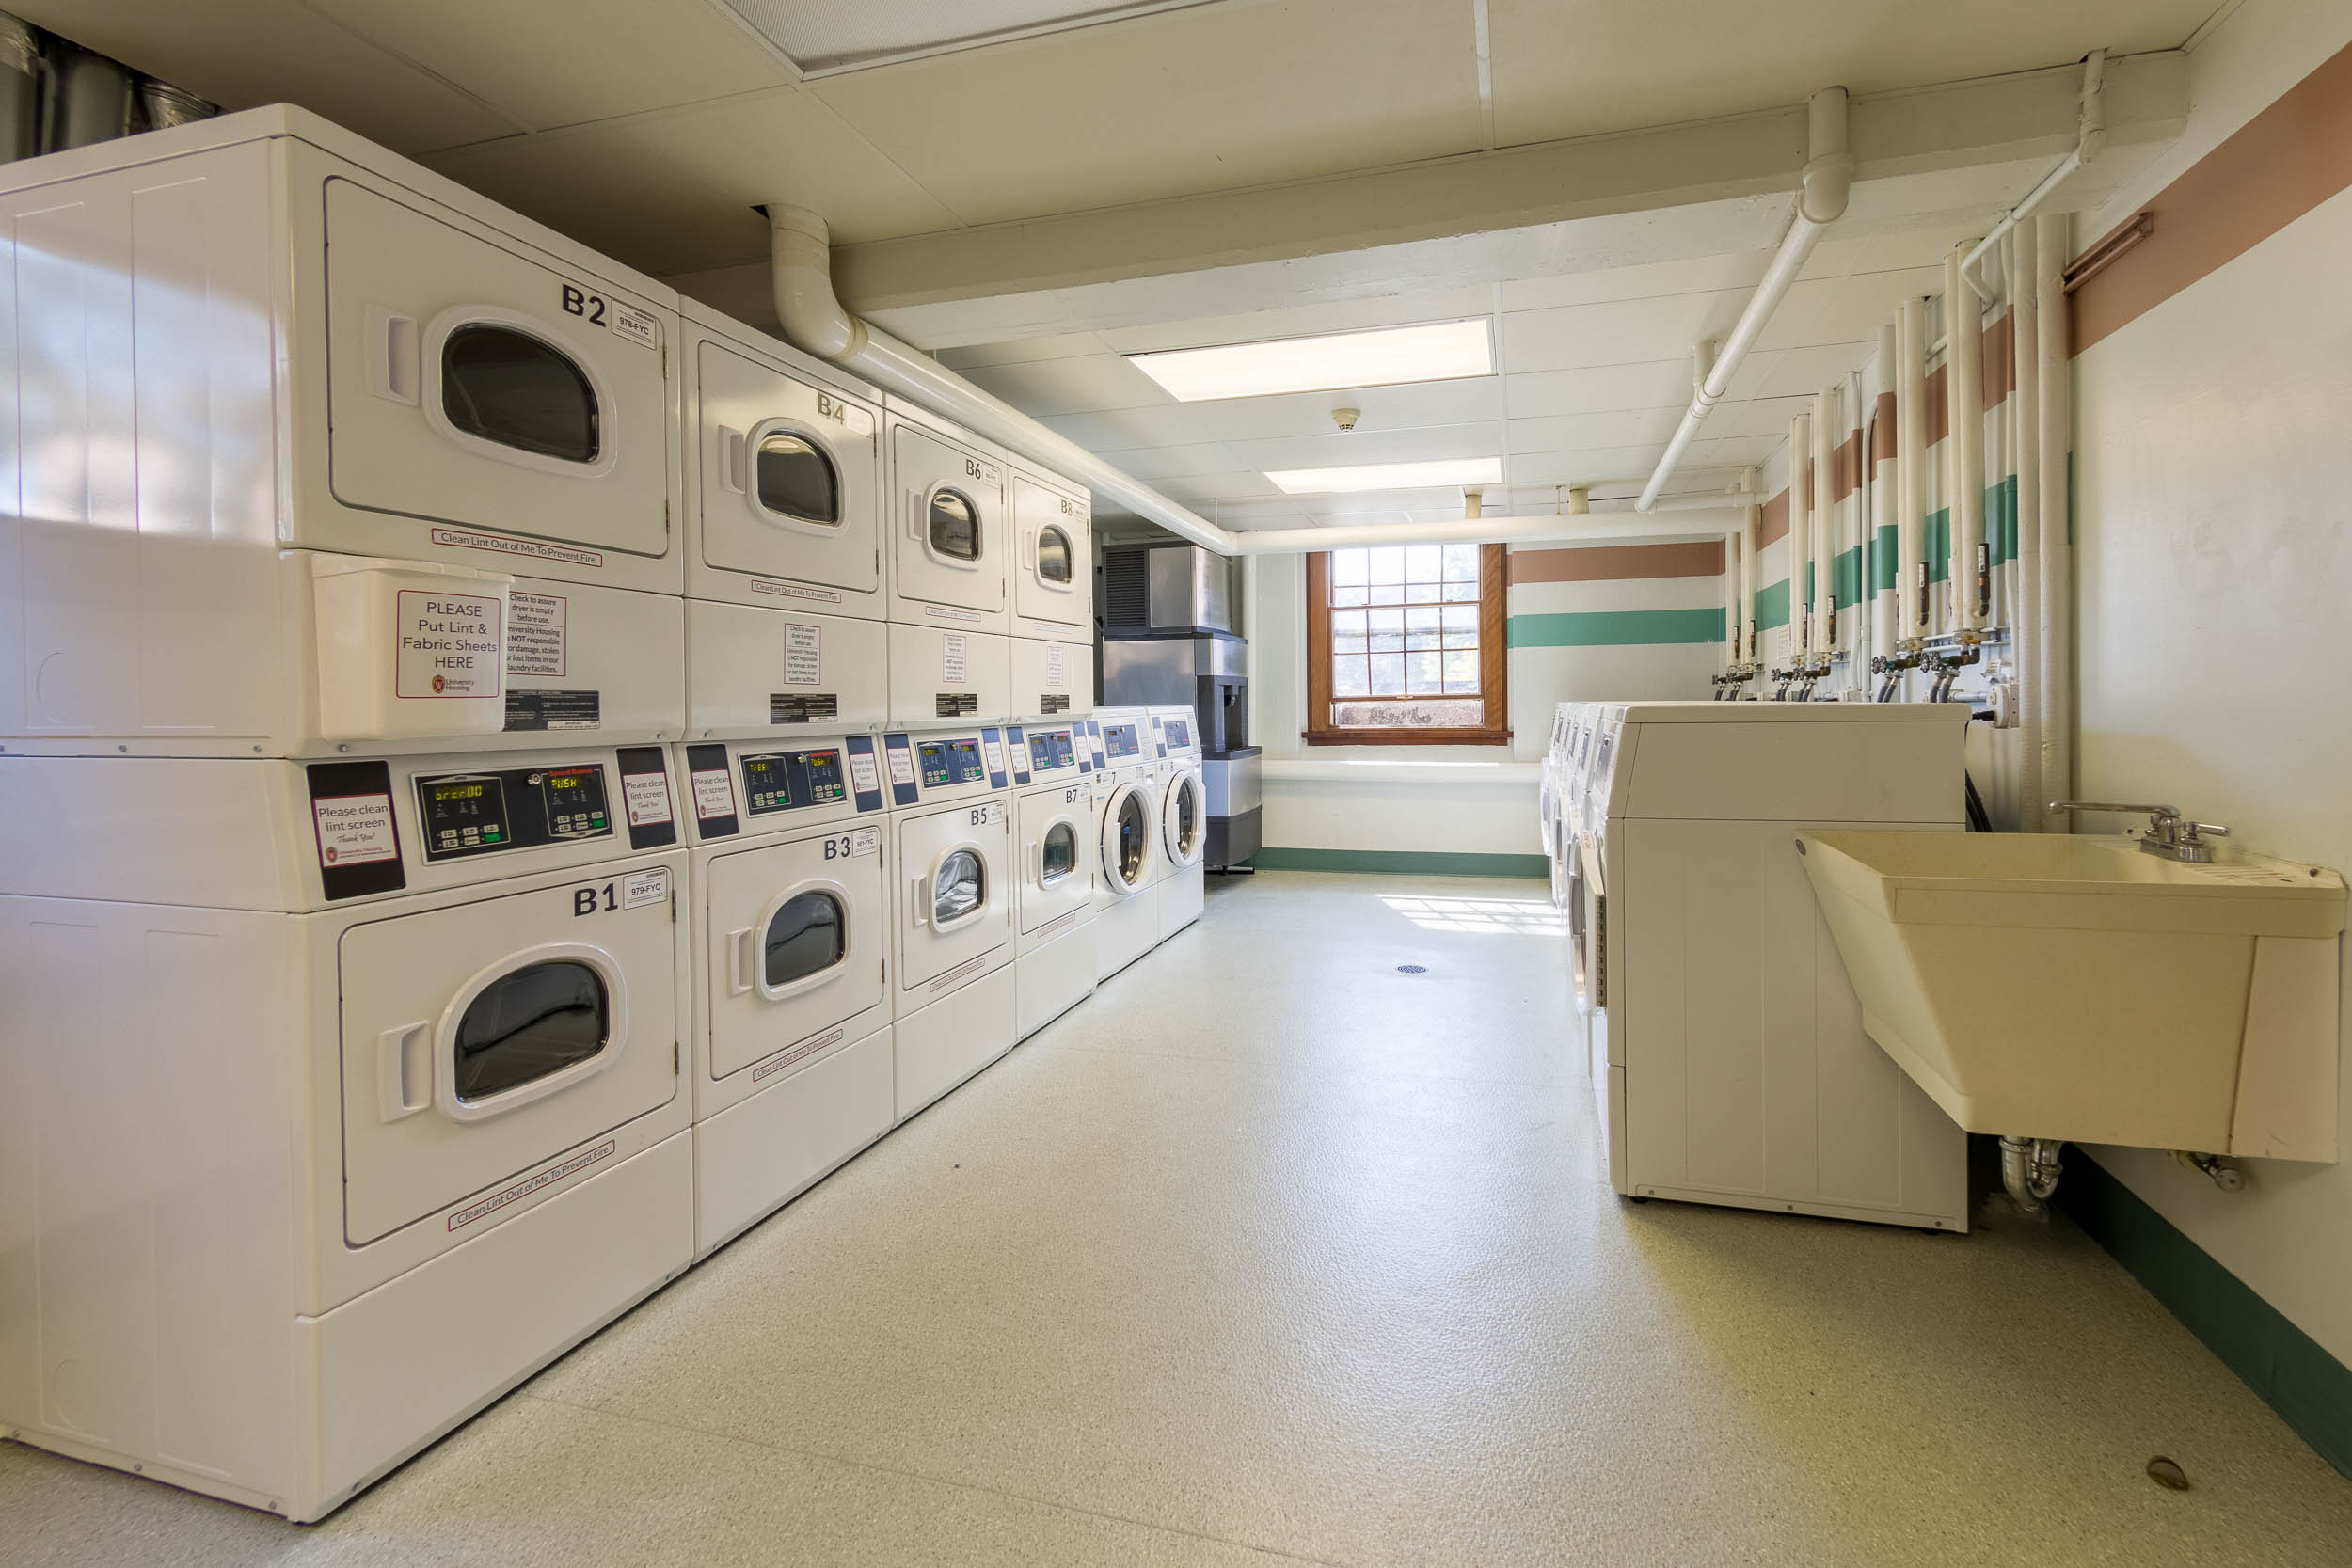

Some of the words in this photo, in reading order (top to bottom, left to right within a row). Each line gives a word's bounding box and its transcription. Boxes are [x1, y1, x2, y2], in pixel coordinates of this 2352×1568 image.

[562, 283, 606, 328] B2
[619, 317, 649, 335] 978-FYC
[818, 392, 845, 425] B4
[965, 459, 981, 480] B6
[1061, 499, 1073, 516] B8
[441, 532, 469, 545] Clean
[471, 536, 489, 547] Lint
[491, 540, 509, 550] Out
[511, 543, 520, 551] of
[521, 545, 535, 554] Me
[536, 546, 547, 555] To
[548, 548, 580, 562] Prevent
[580, 553, 596, 563] Fire
[510, 594, 529, 602] Check
[427, 602, 482, 617] PLEASE
[512, 604, 529, 612] dryer
[535, 608, 554, 616] empty
[517, 614, 537, 623] before
[419, 619, 444, 632] Put
[450, 622, 474, 634] Lint
[478, 623, 487, 635] &
[508, 625, 535, 635] niversity
[536, 627, 560, 637] Housing
[403, 637, 452, 650] Fabric
[456, 640, 497, 652] Sheets
[435, 657, 474, 669] HERE
[513, 654, 524, 662] lost
[508, 663, 530, 672] laundry
[1066, 789, 1077, 803] B7
[319, 807, 357, 817] Please
[358, 805, 389, 815] clean
[971, 807, 987, 826] B5
[326, 821, 345, 832] lint
[347, 819, 385, 830] screen
[824, 836, 850, 860] B3
[631, 883, 660, 895] 979-FYC
[574, 882, 618, 917] B1
[457, 1206, 485, 1224] Clean
[486, 1196, 504, 1211] Lint
[506, 1188, 523, 1201] Out
[524, 1181, 534, 1193] of
[535, 1175, 549, 1186] Me
[551, 1169, 561, 1180] To
[562, 1155, 592, 1174] Prevent
[594, 1146, 609, 1160] Fire
